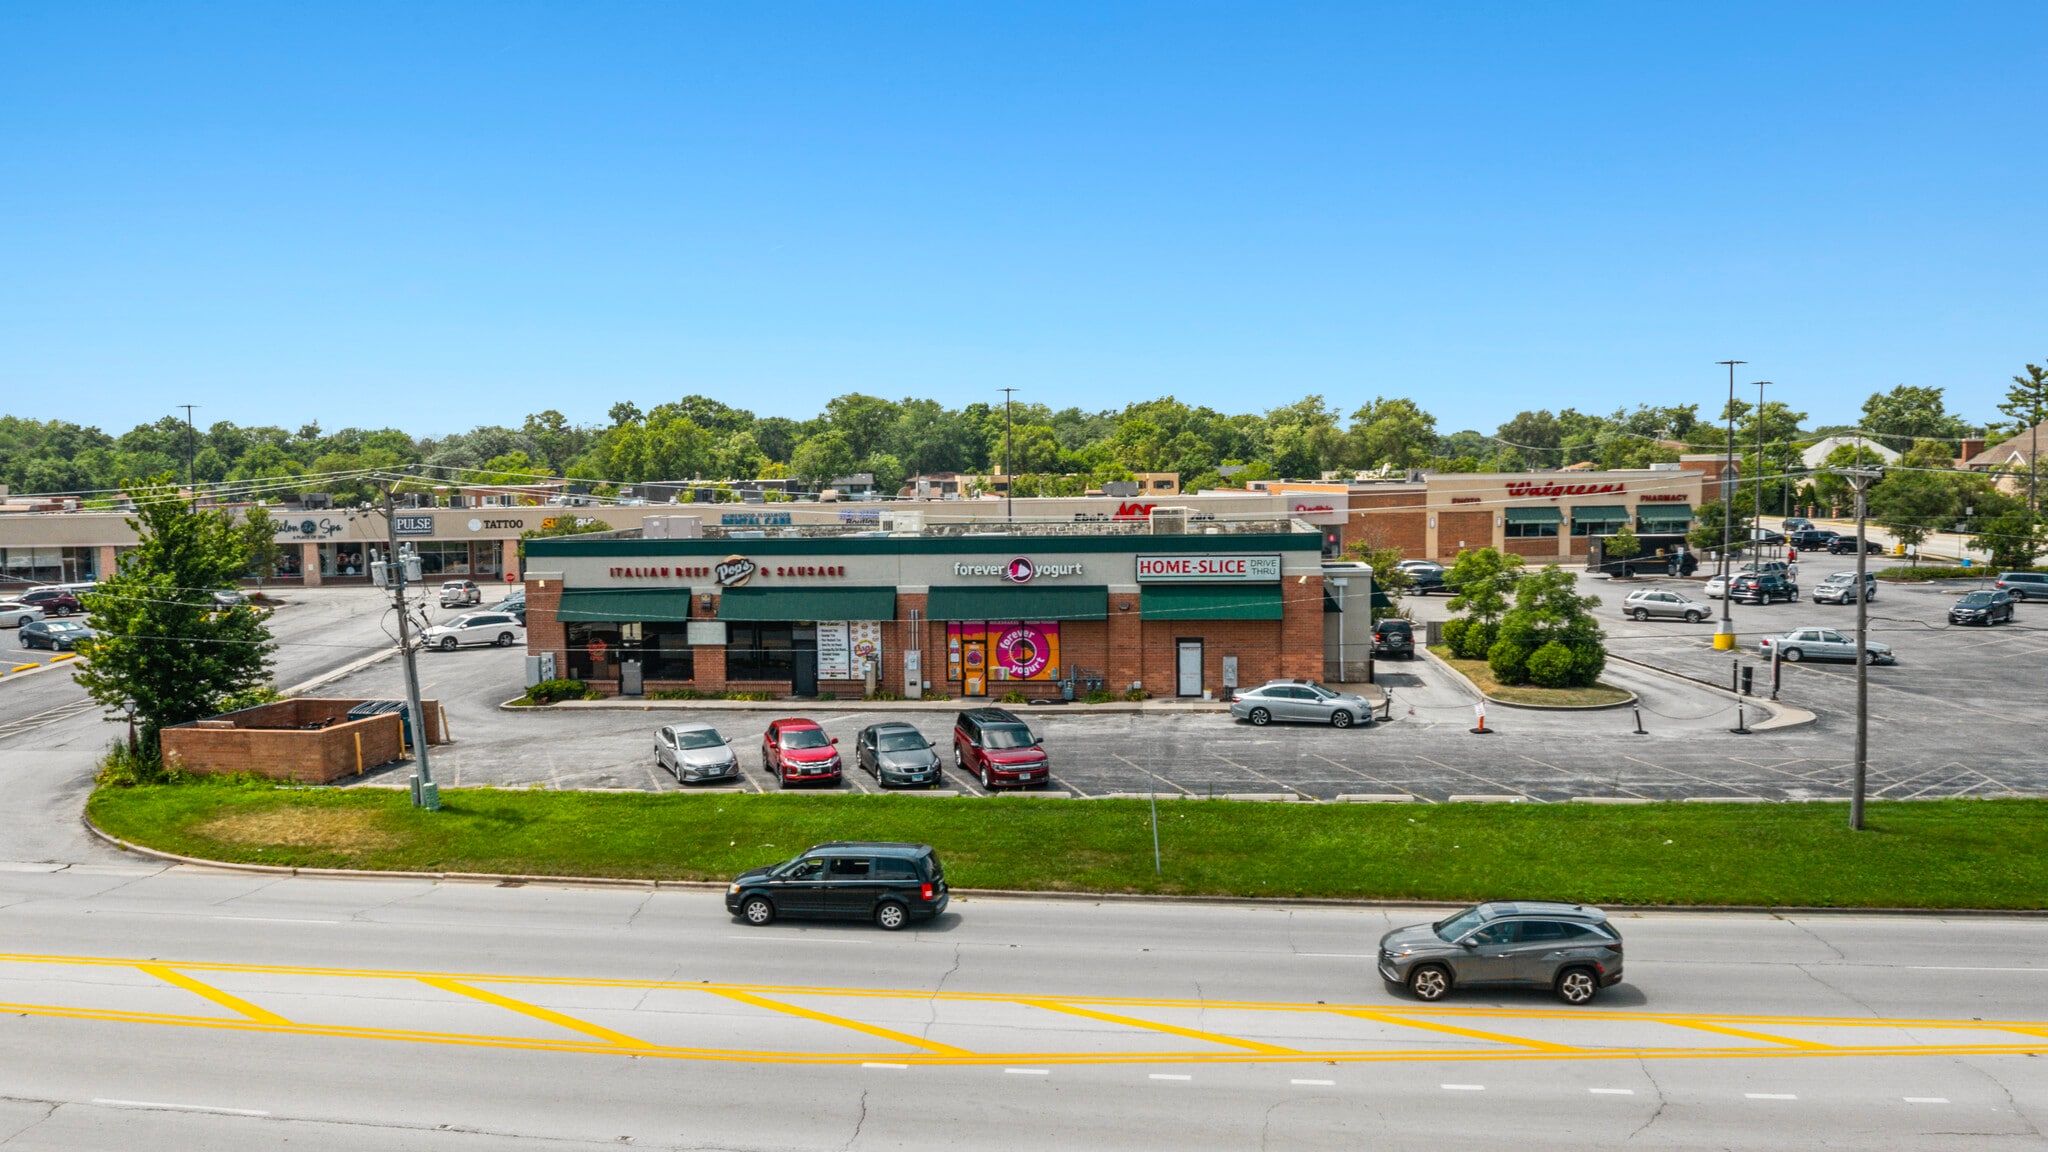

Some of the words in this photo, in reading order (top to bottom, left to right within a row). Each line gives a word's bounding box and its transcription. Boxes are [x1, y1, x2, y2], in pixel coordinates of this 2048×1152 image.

[1505, 481, 1627, 501] Walgreens
[1640, 494, 1688, 503] PHARMACY
[1111, 501, 1158, 521] ACE
[319, 518, 343, 536] Spa
[396, 518, 432, 530] PULSE
[484, 520, 523, 529] TATTOO
[610, 567, 669, 578] ITALIAN
[675, 567, 710, 577] BEEF
[718, 560, 752, 580] Pop's
[760, 567, 769, 577] &
[777, 566, 845, 577] SAUSAGE
[953, 562, 1005, 576] forever
[1034, 562, 1083, 579] yogurt
[1138, 560, 1247, 574] HOME-SLICE
[1250, 559, 1277, 567] DRIVE
[1251, 568, 1277, 576] THRU
[1000, 629, 1036, 649] forever
[1010, 657, 1046, 676] yogurt
